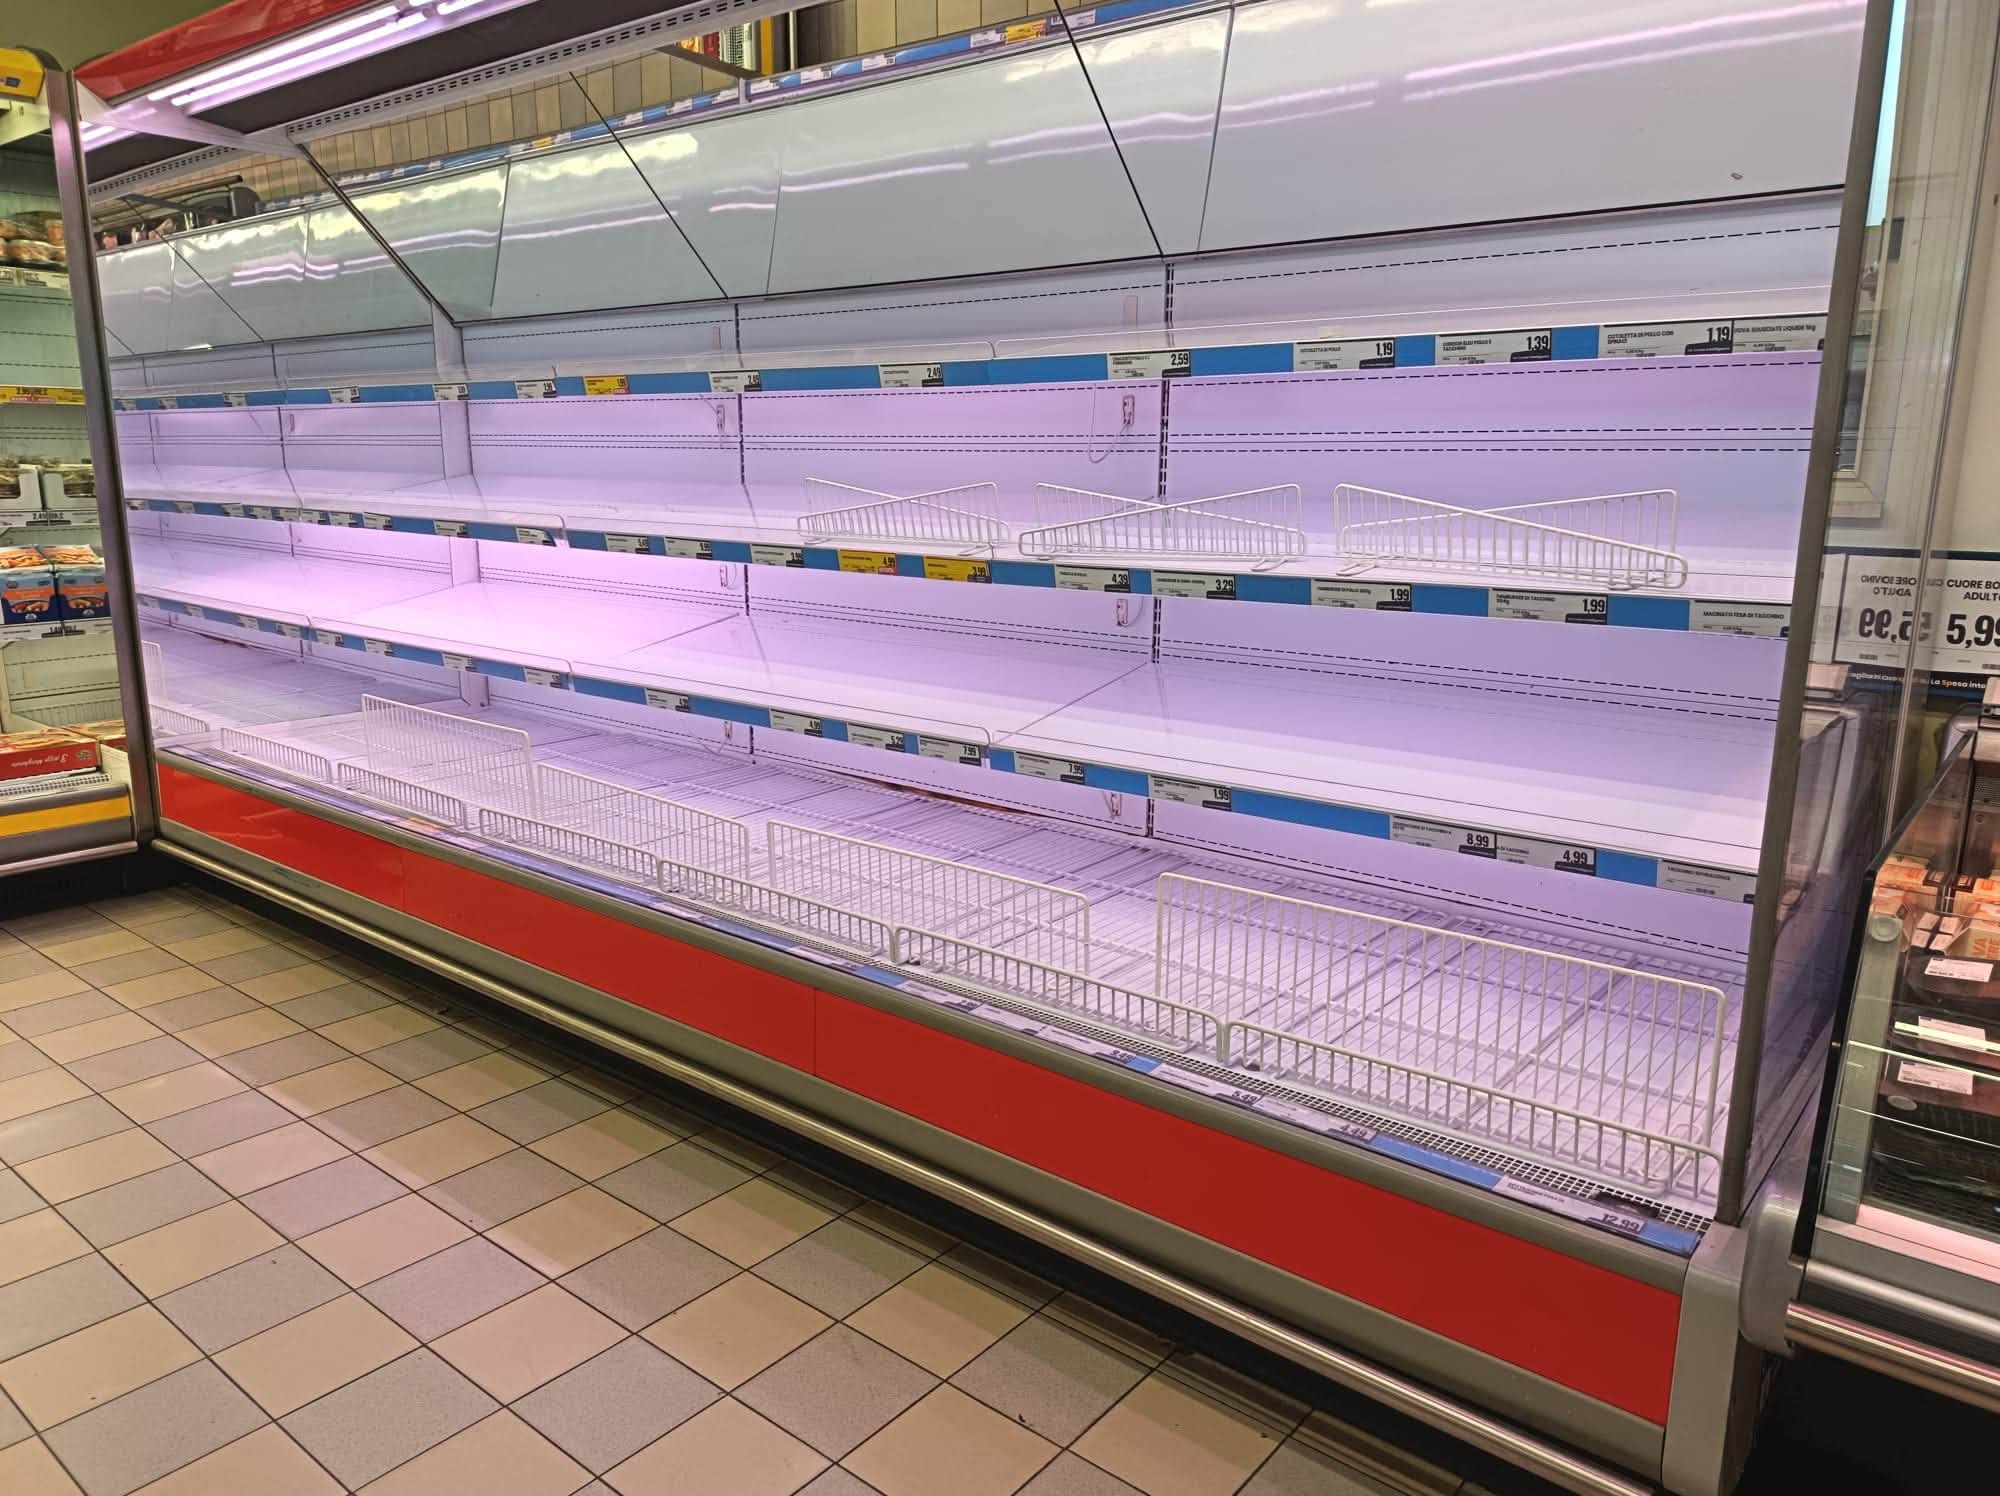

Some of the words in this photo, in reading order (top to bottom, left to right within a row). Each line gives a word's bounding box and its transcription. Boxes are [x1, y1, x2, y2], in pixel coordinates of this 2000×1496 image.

[1376, 342, 1393, 356] 1,19
[1527, 335, 1549, 350] 1,39
[1170, 353, 1189, 366] 2,59
[1111, 573, 1128, 585] 4,39
[1215, 579, 1233, 592] 3,29
[1947, 579, 1982, 589] CUORE
[1390, 588, 1409, 601] 1,99
[1963, 592, 2000, 601] ADULT
[1582, 598, 1605, 613] 1,99
[1213, 788, 1229, 801] 1,99
[1467, 832, 1489, 848] 8,99
[1563, 849, 1588, 865] 4,99
[1339, 1124, 1368, 1139] 4,49
[1600, 1213, 1640, 1232] 12,99
